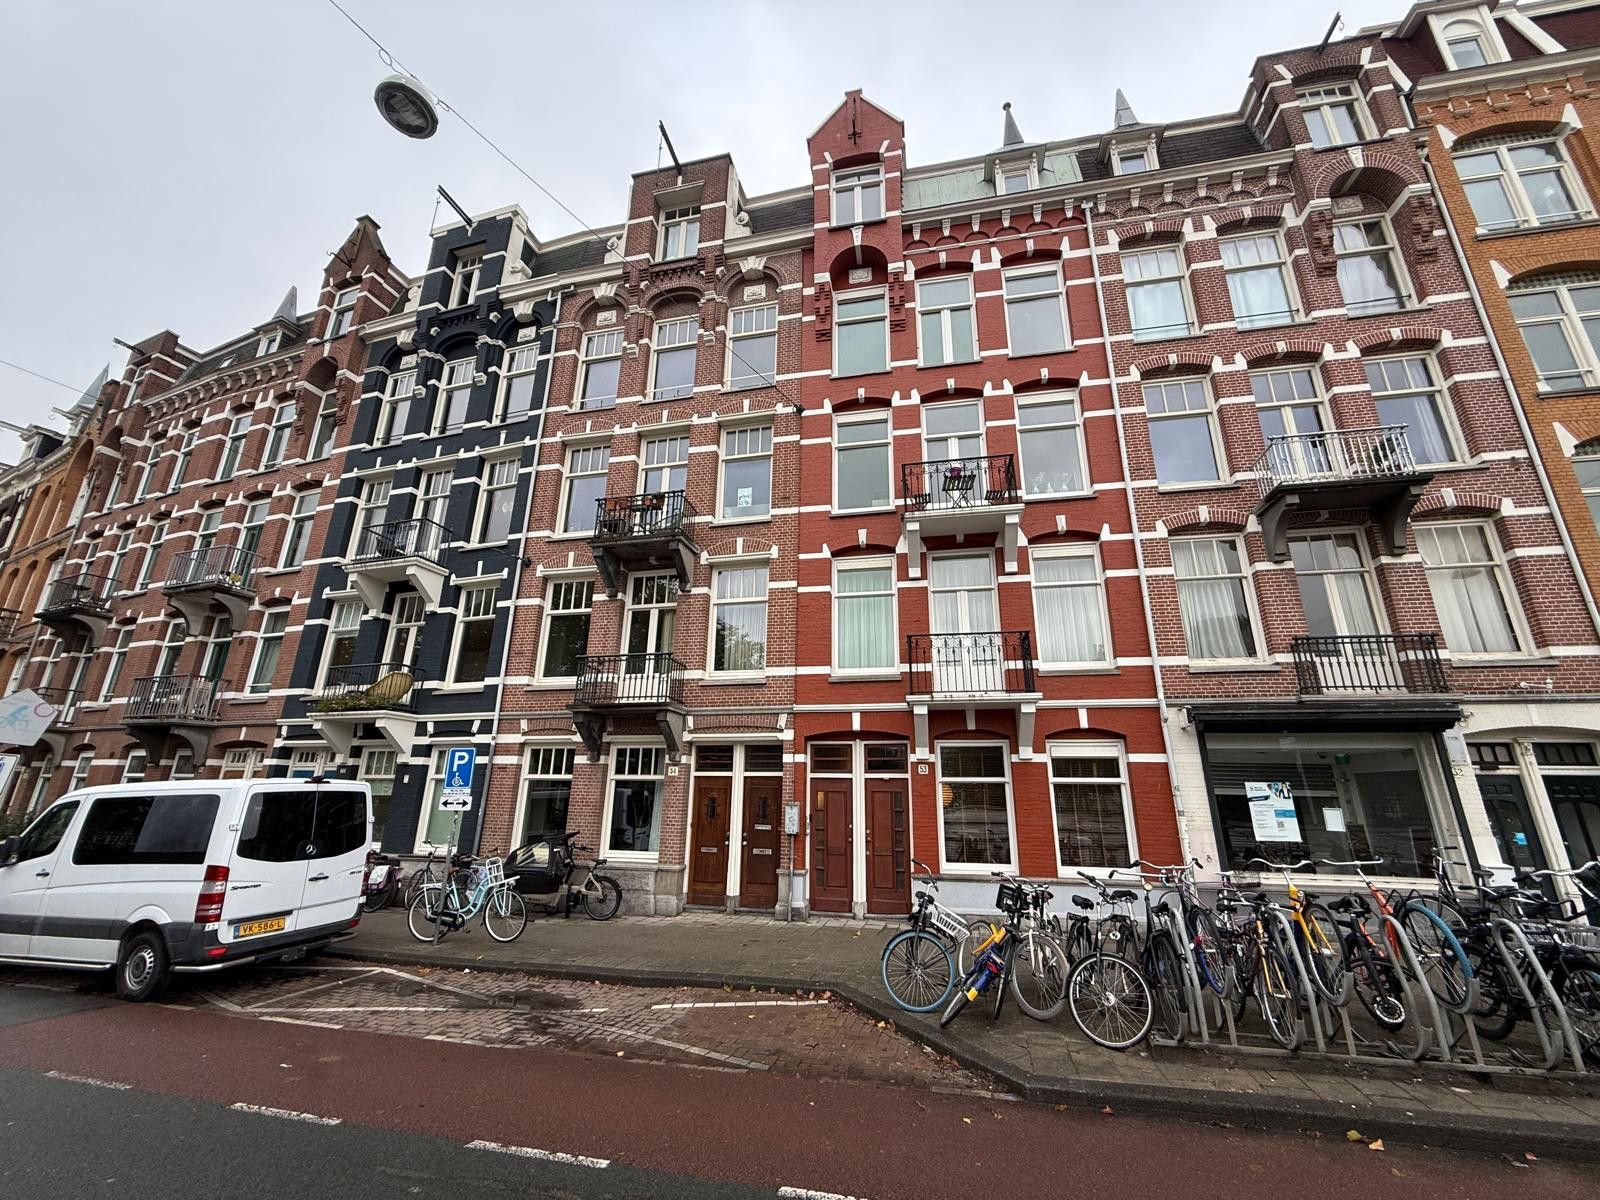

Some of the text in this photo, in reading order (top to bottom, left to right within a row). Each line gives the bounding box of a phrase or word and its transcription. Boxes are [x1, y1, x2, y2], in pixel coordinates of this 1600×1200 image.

[453, 751, 470, 772] P
[919, 765, 927, 774] 53
[1452, 767, 1464, 777] 52
[242, 920, 282, 934] VK-586-L
